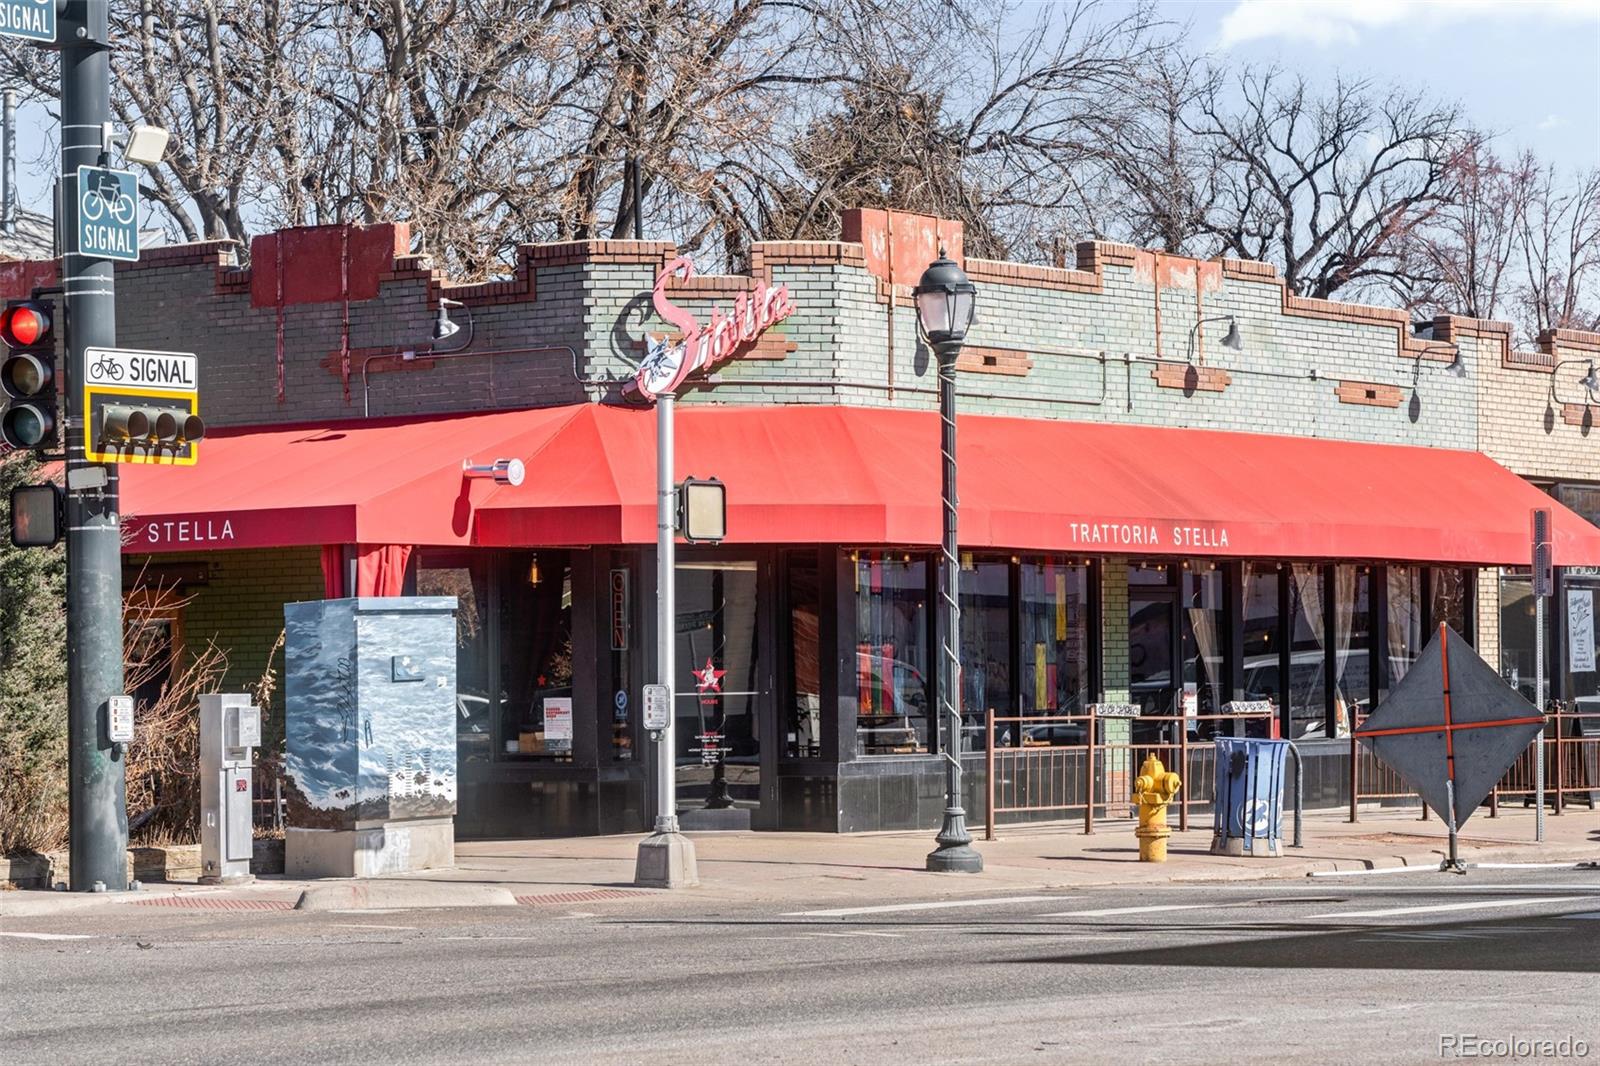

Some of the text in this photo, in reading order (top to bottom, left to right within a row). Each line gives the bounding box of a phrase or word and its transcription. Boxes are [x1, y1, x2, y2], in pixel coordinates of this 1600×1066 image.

[0, 2, 50, 34] SIGNAL
[84, 224, 134, 253] SIGNAL
[129, 357, 193, 385] SIGNAL
[147, 519, 235, 543] STELLA
[1070, 523, 1229, 547] TRATTORIA STELLA
[612, 572, 625, 648] OPEN
